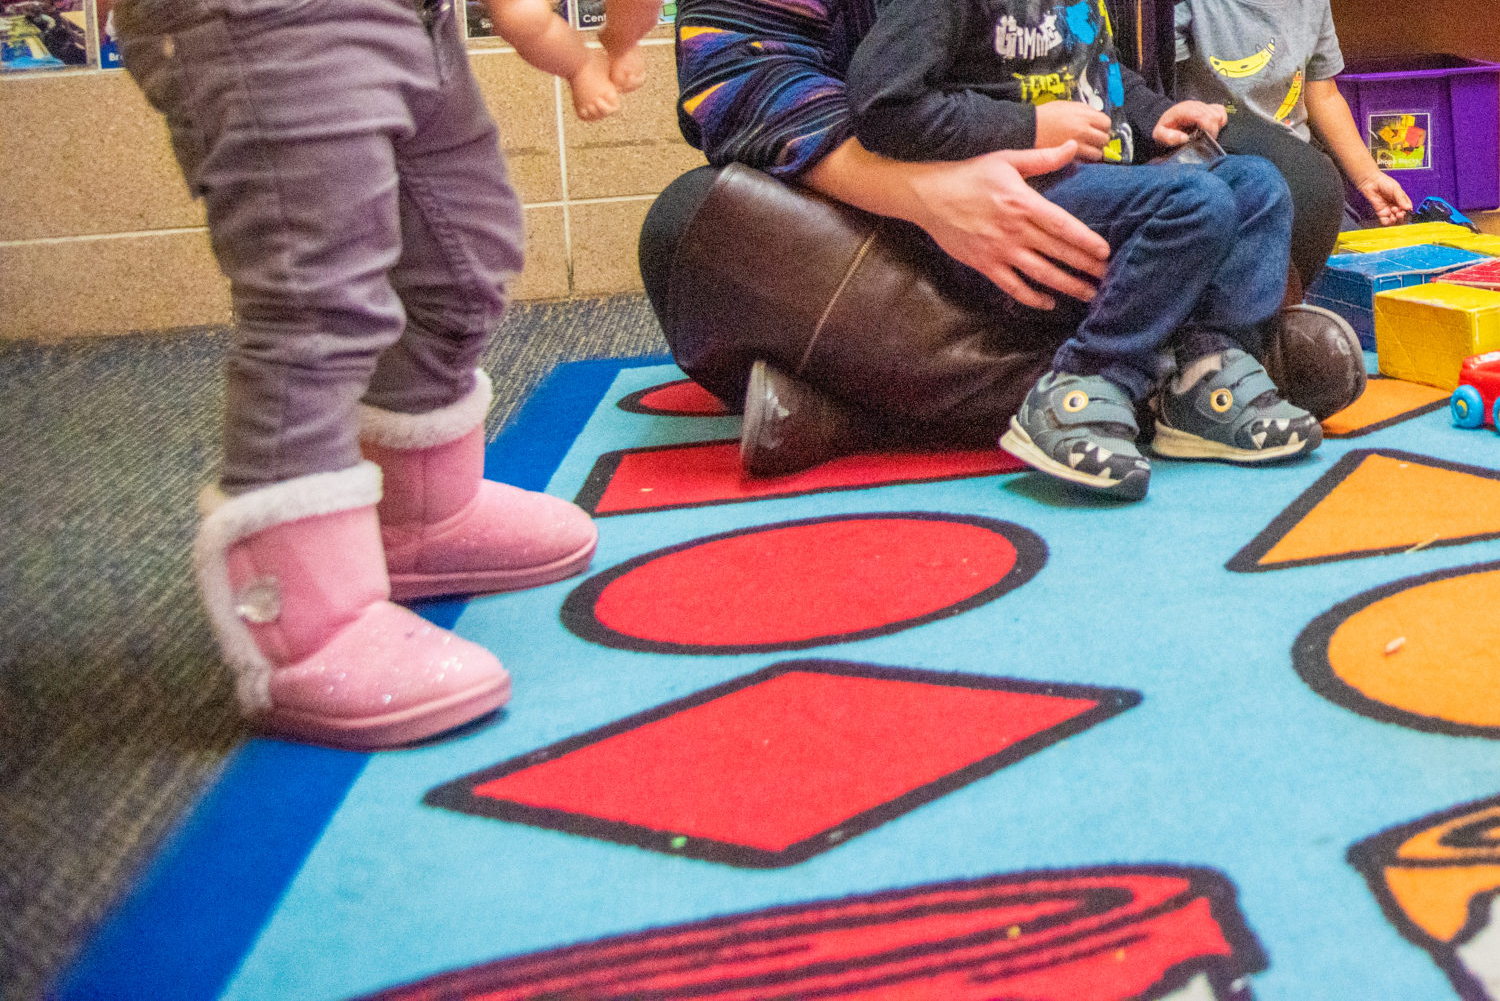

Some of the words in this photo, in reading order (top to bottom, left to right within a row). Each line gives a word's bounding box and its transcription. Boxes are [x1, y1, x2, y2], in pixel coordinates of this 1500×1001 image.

[583, 13, 607, 24] Cent
[1376, 158, 1396, 166] Shape
[1398, 158, 1420, 166] Blocks
